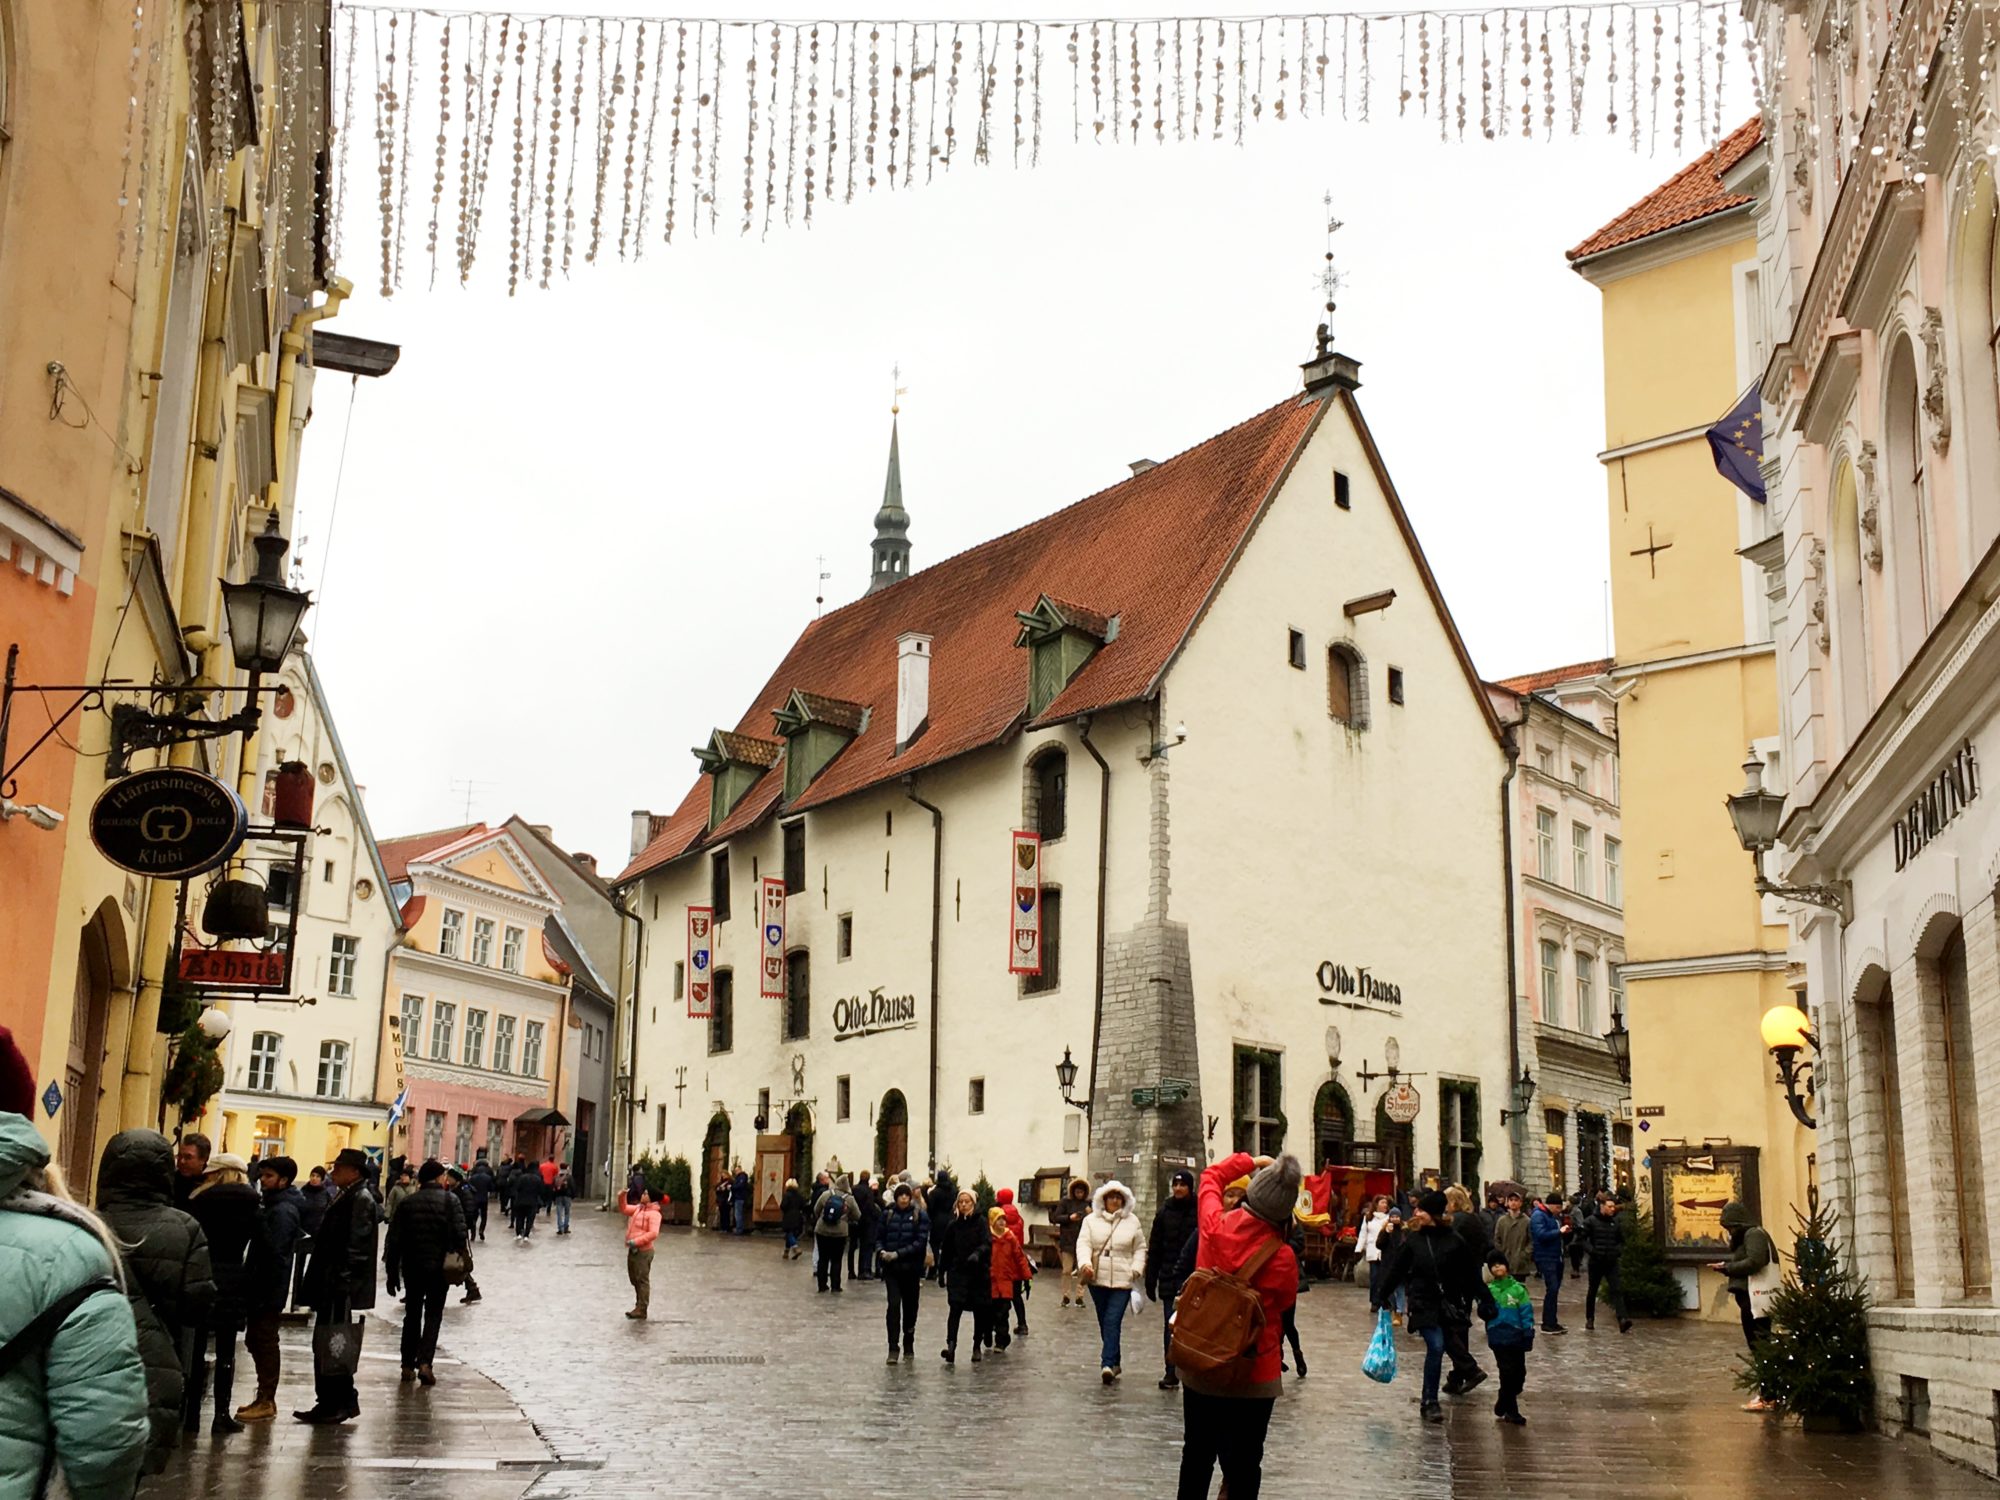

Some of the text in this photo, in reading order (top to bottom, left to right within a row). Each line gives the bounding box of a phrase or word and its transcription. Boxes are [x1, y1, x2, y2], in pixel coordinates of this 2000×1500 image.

[138, 848, 183, 865] Klubi
[1315, 960, 1355, 995] Olde
[832, 995, 867, 1033] Olde
[391, 1033, 408, 1136] MUUSM
